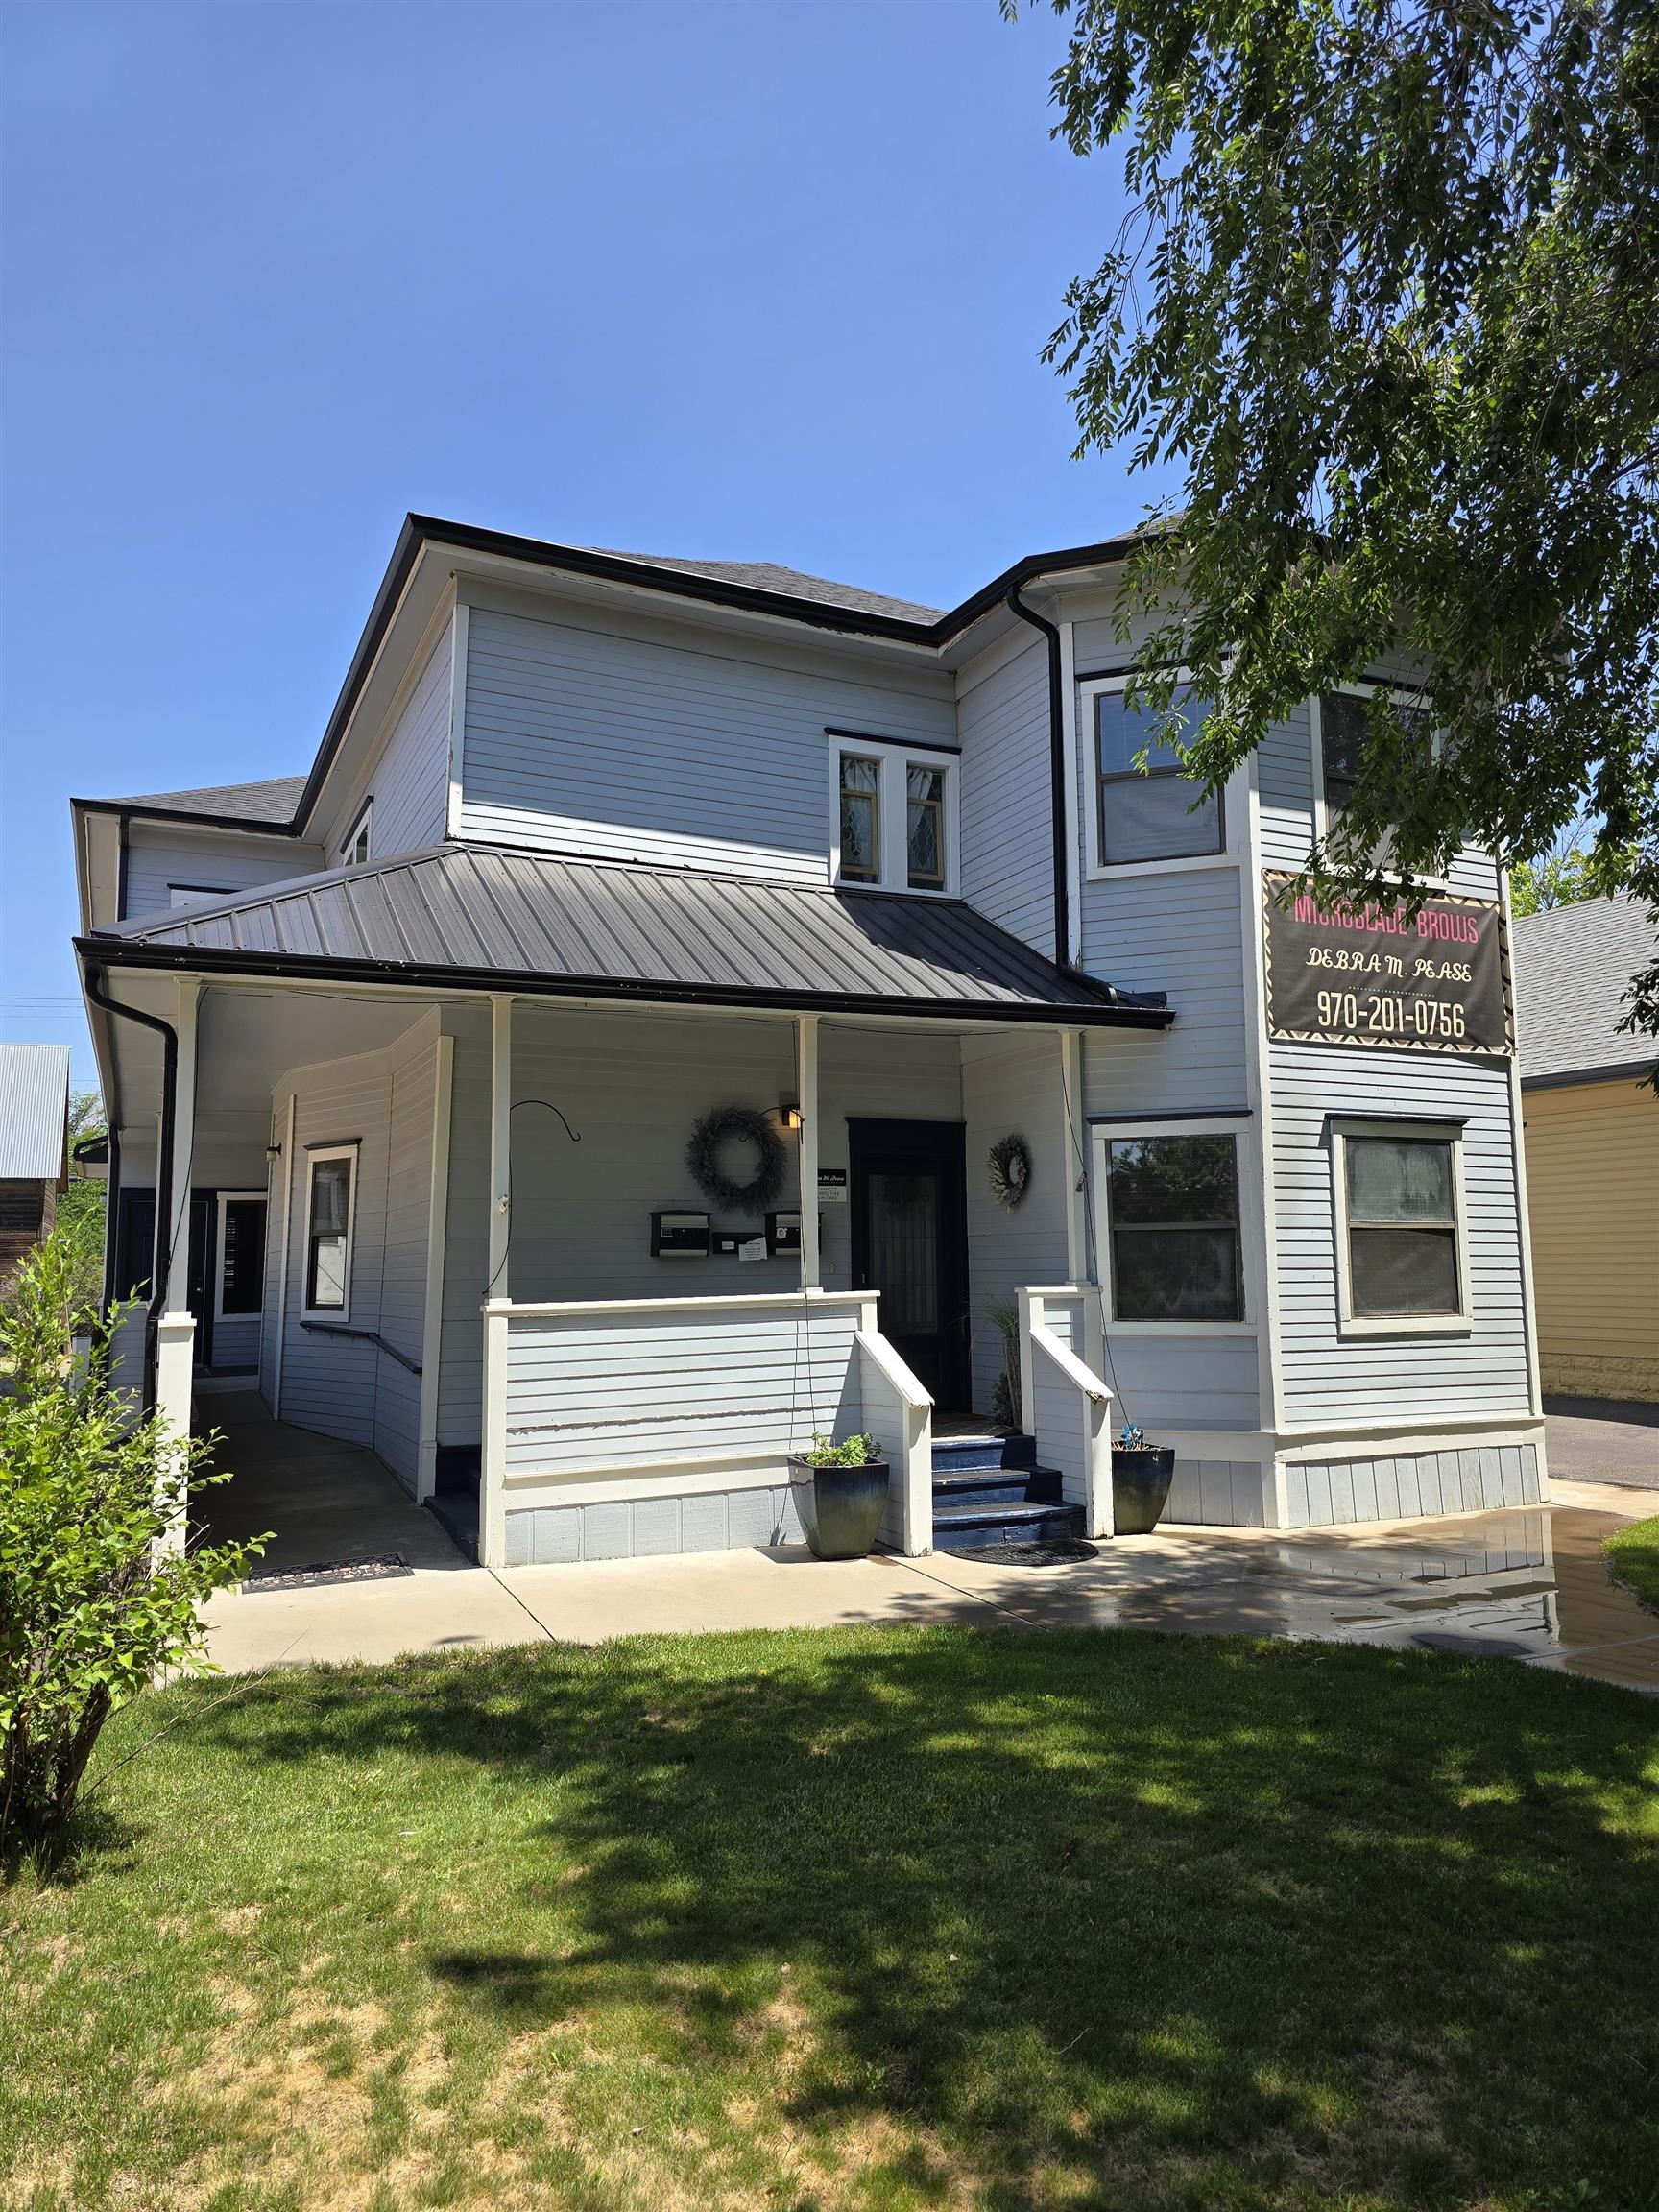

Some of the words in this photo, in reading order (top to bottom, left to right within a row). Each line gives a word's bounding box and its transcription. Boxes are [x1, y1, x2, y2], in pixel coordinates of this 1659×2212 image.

[1415, 909, 1479, 944] BROWS
[1306, 947, 1382, 973] DEBRA
[1384, 954, 1408, 978] M.
[1412, 958, 1472, 982] PEASE
[1316, 990, 1465, 1038] 970-201-0756
